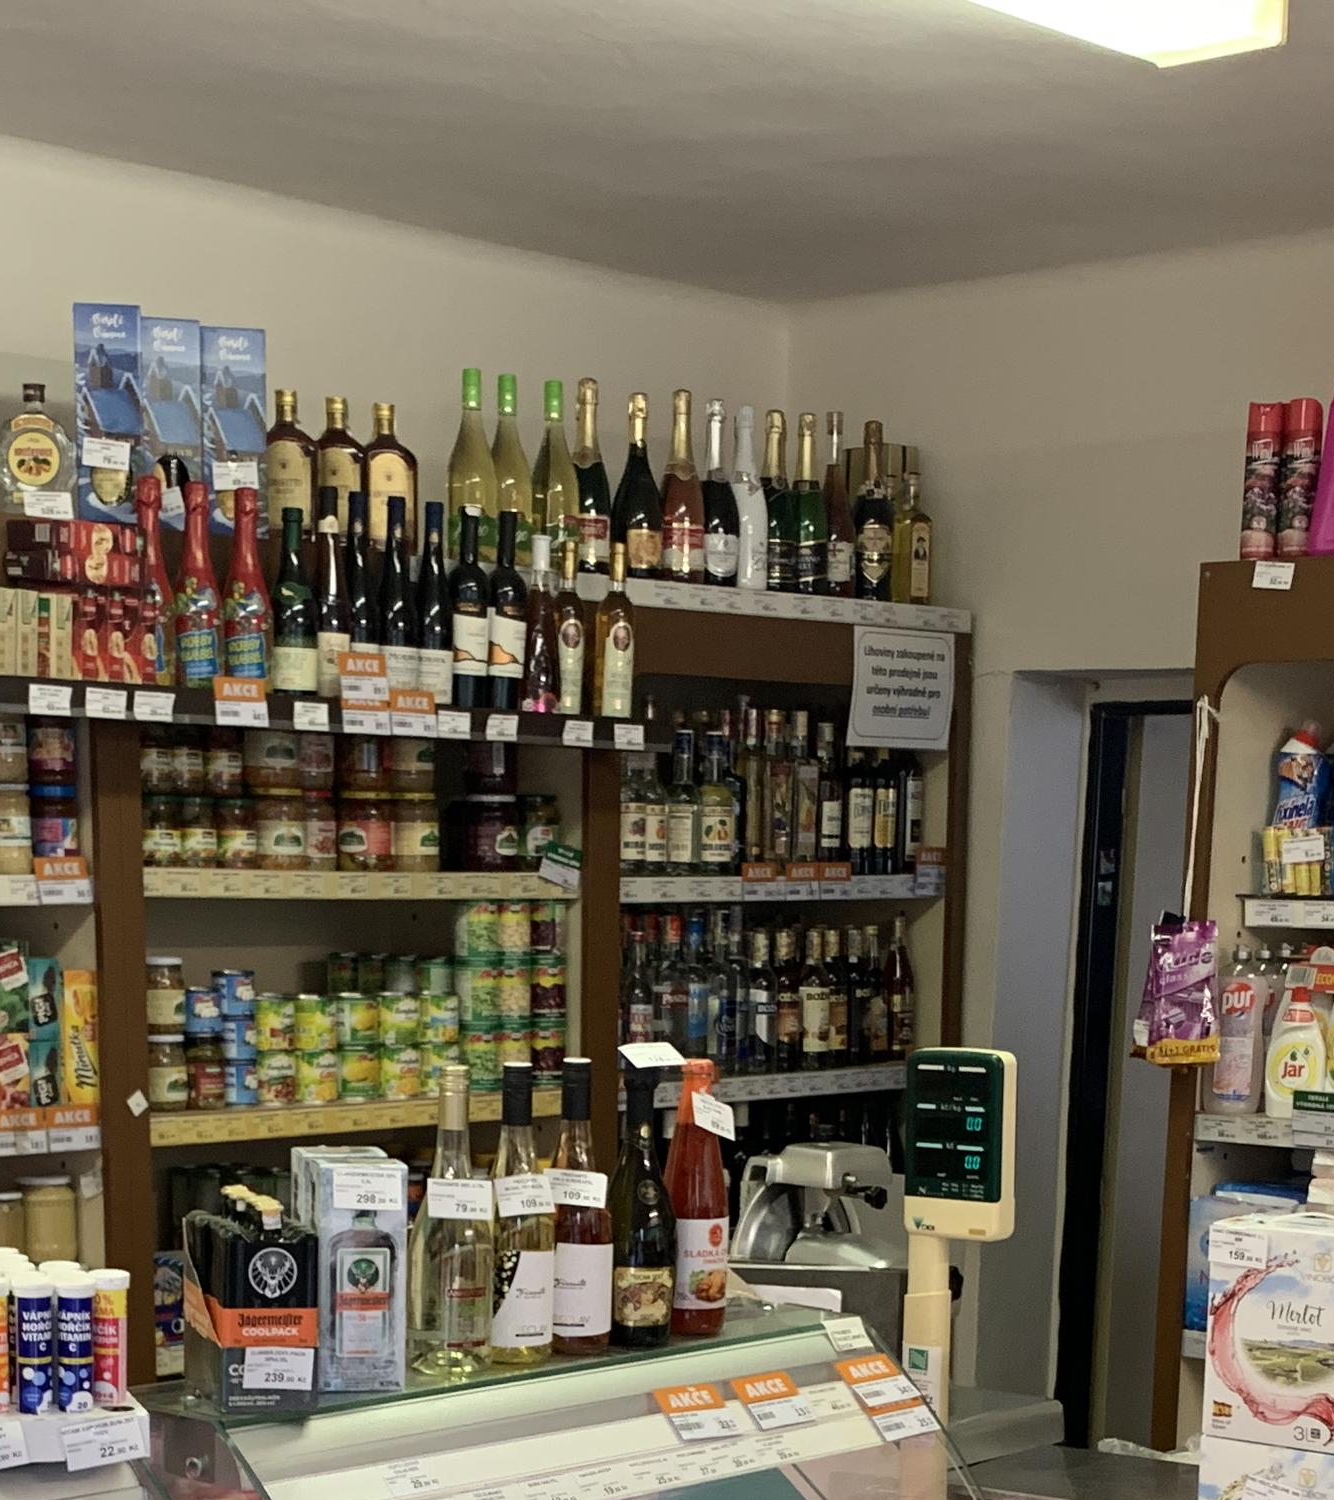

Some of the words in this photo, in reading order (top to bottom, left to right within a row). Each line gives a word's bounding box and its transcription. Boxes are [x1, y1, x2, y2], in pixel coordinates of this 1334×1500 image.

[1222, 990, 1254, 1012] pur
[1183, 1043, 1216, 1055] GRATIS
[1281, 1060, 1305, 1078] Jar
[1269, 1298, 1326, 1328] Merlot
[242, 1327, 300, 1337] COOLPACK
